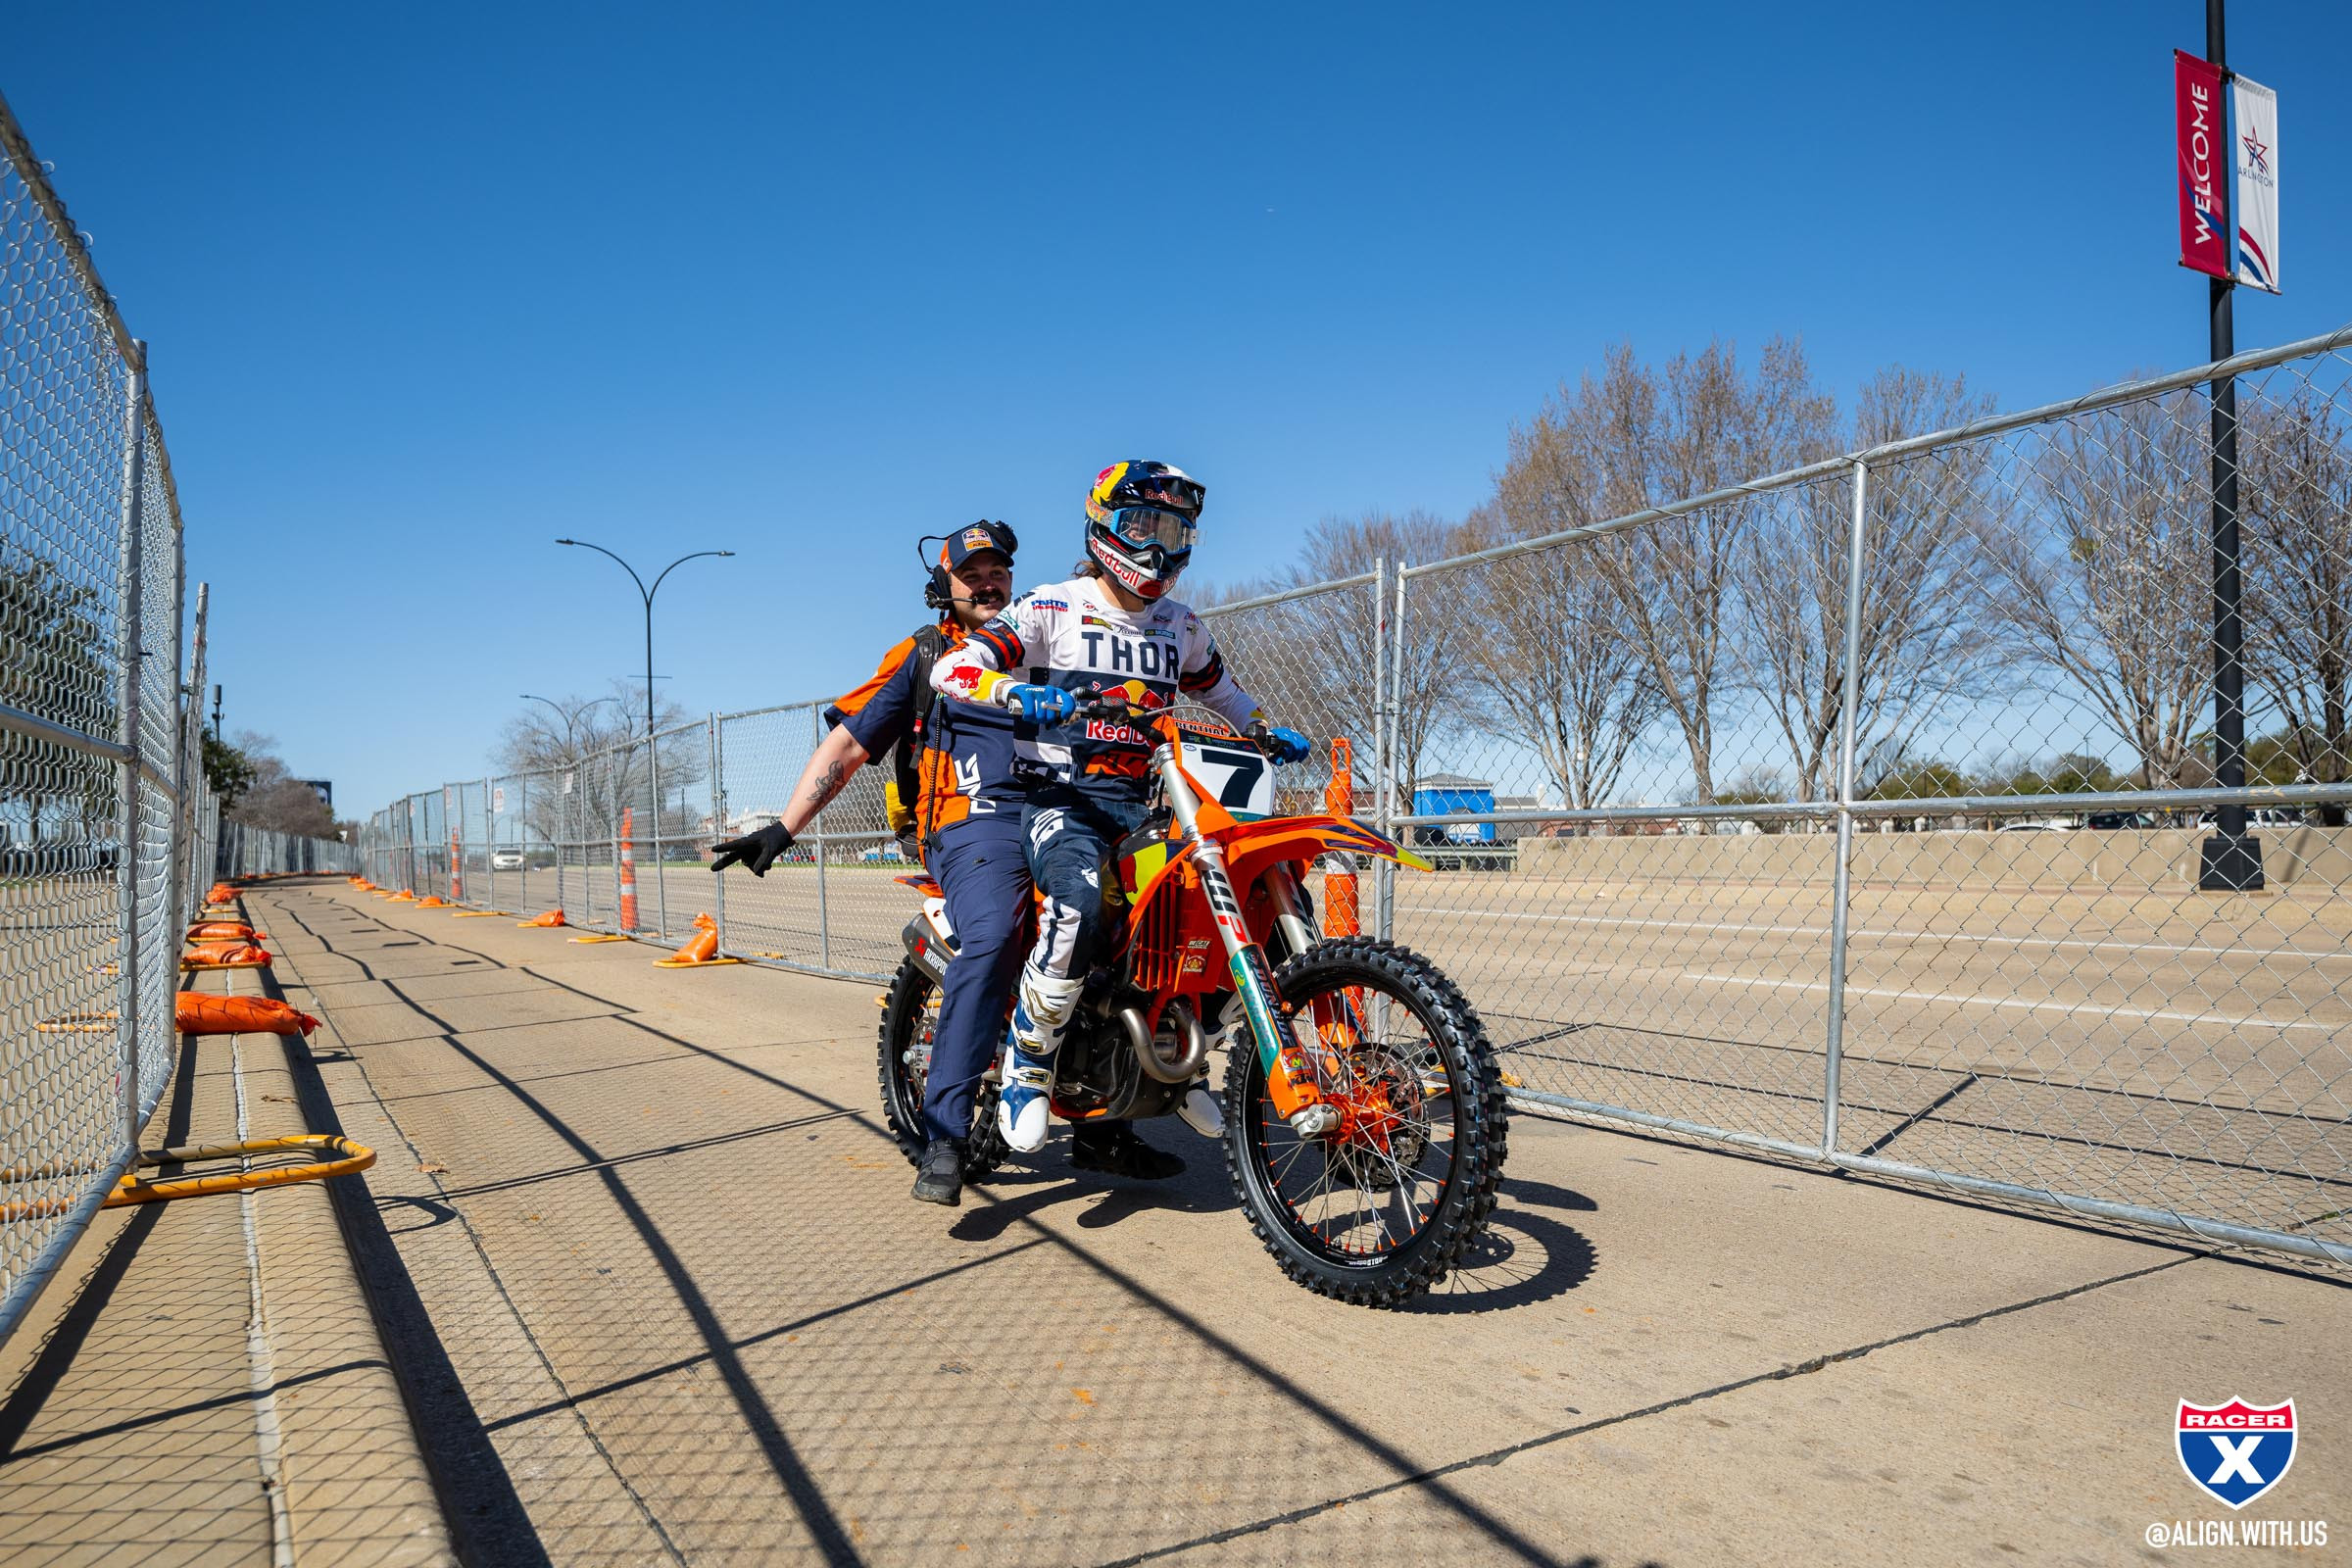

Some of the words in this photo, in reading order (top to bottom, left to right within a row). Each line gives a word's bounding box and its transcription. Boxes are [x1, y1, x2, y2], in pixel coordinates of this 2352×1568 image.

[2191, 81, 2212, 245] WELCOME
[2237, 166, 2275, 189] ARLINGTON
[1030, 599, 1068, 609] PARTS
[1081, 631, 1180, 680] THOR
[1086, 718, 1132, 744] Red
[1200, 748, 1264, 808] 7
